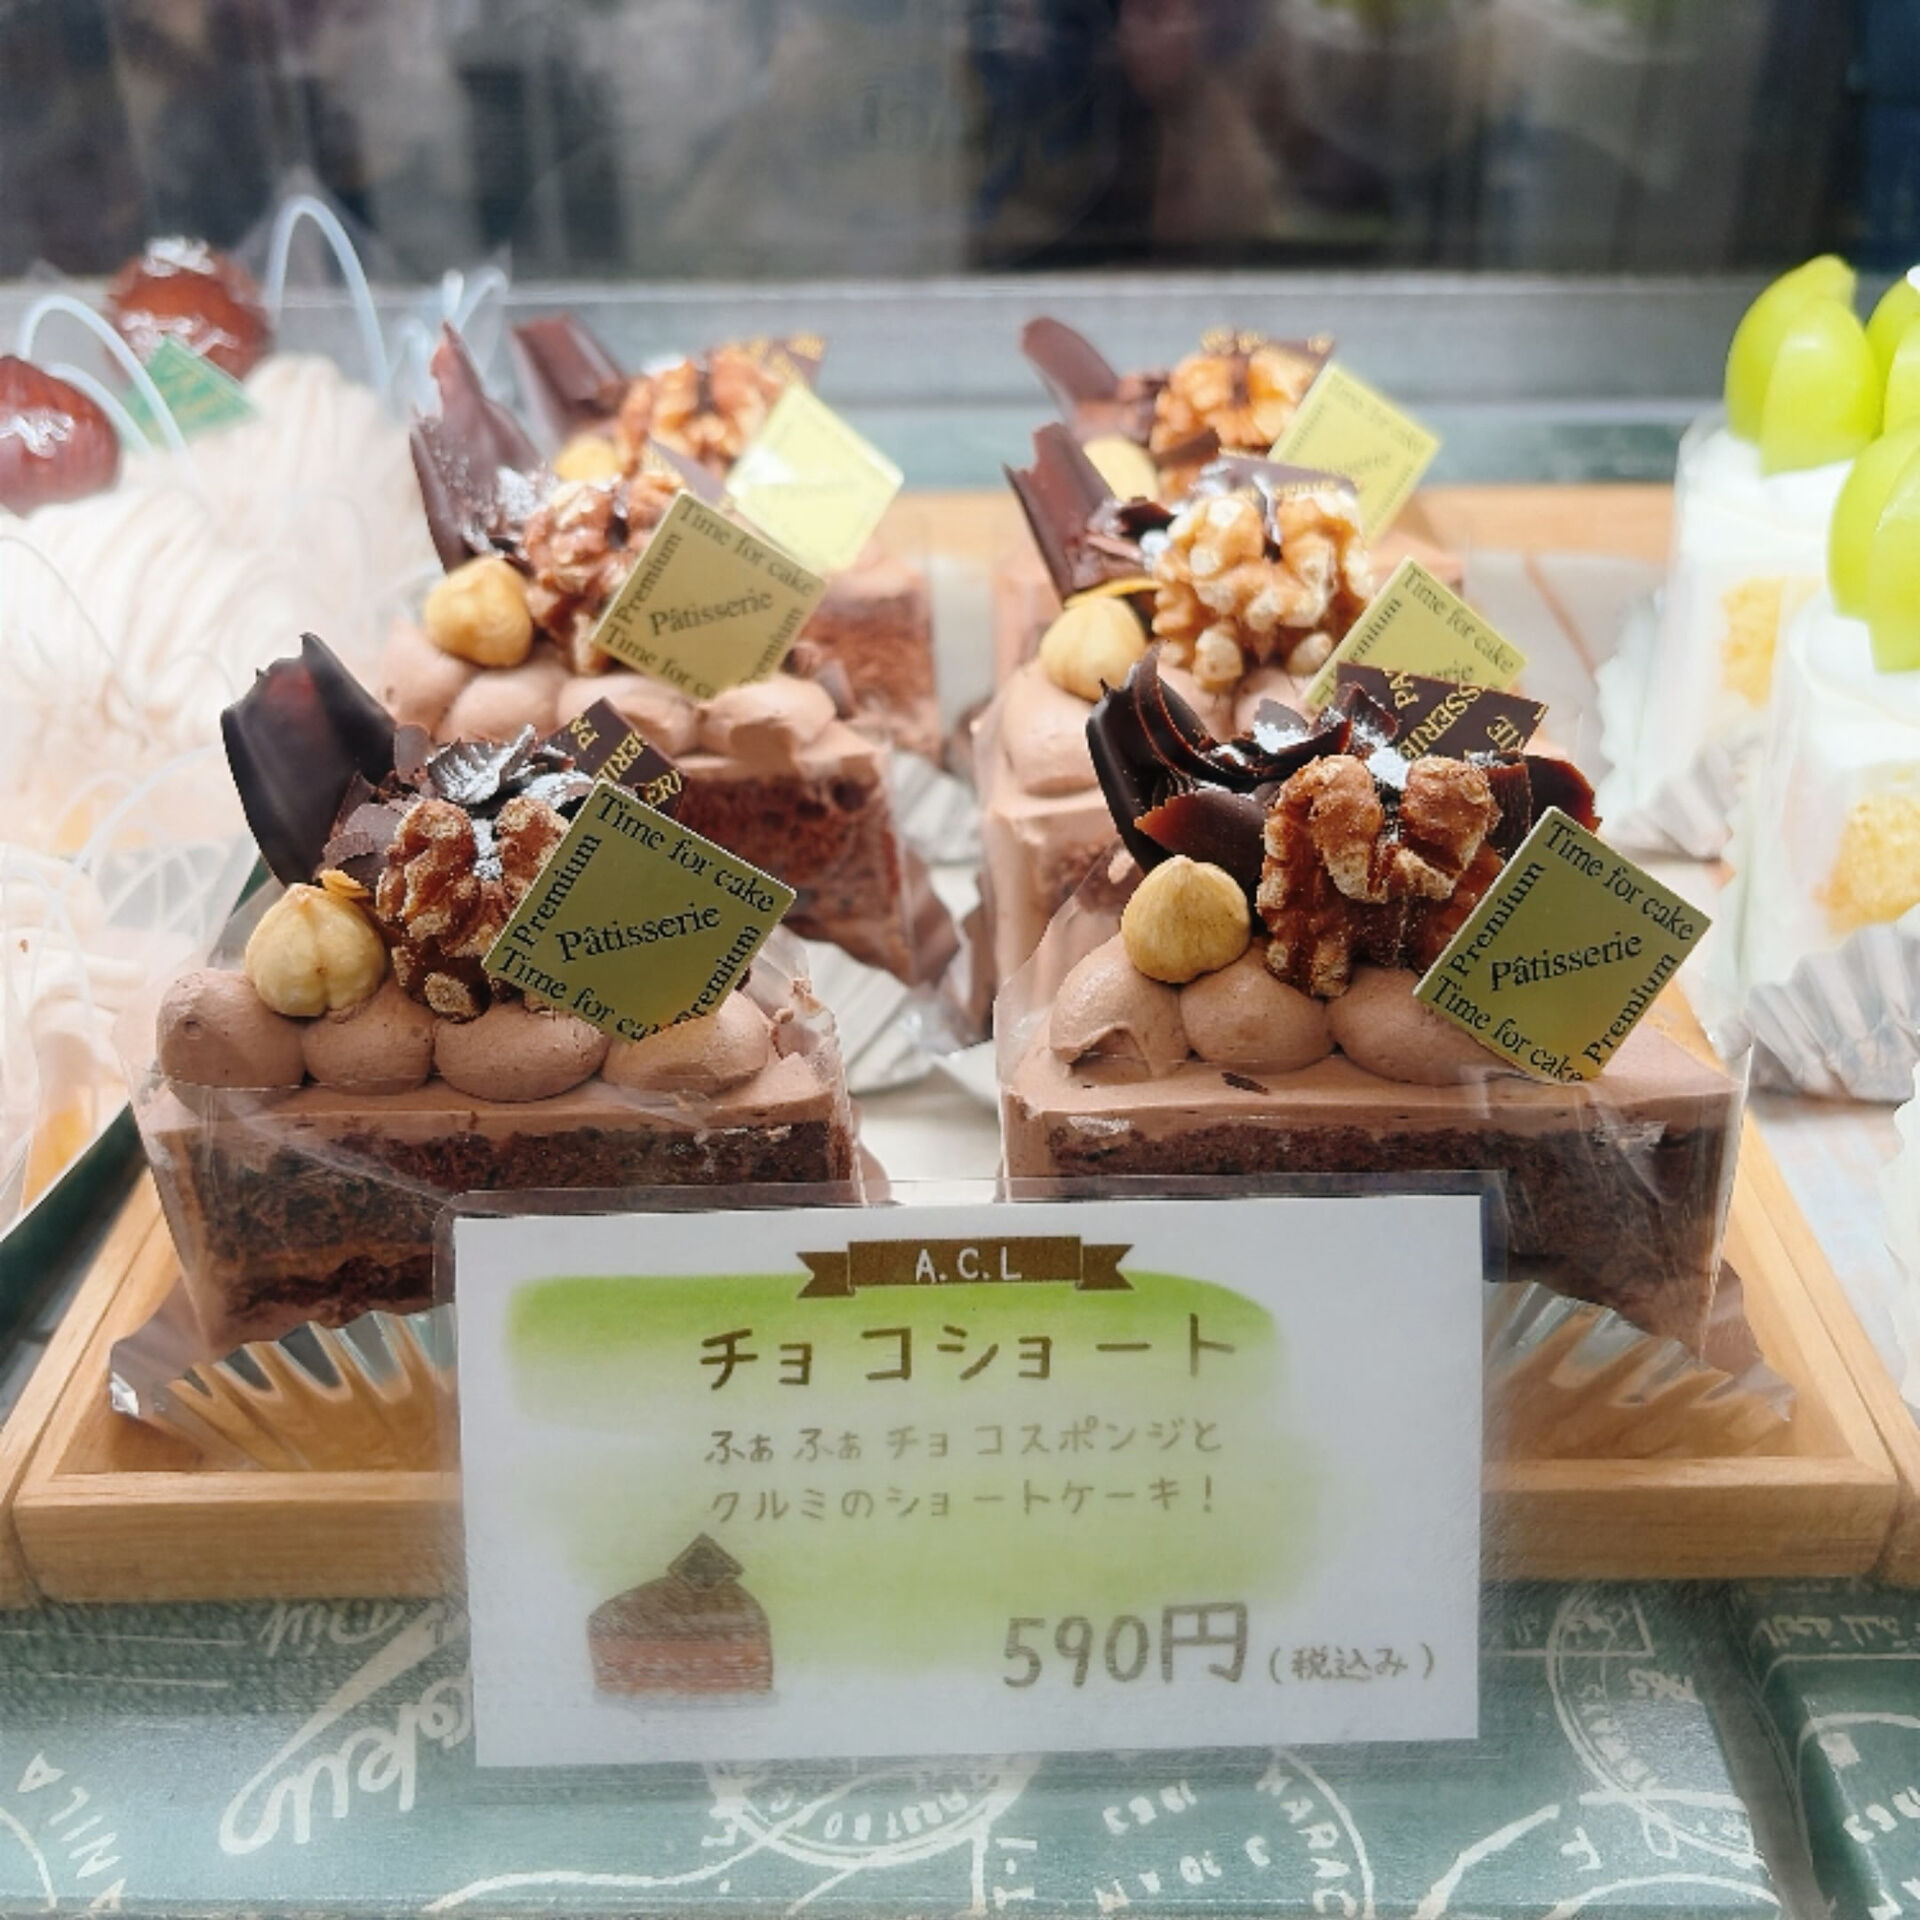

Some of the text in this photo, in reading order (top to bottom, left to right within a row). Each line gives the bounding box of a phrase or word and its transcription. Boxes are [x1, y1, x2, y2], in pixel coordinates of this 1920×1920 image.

[614, 533, 683, 626] Premium
[679, 500, 815, 598] Time for cake
[605, 624, 657, 664] Time
[1401, 567, 1448, 617] Time
[1474, 636, 1515, 675] cake
[511, 832, 602, 949] Premium
[596, 791, 775, 914] Time for cake
[1543, 819, 1694, 941] Time for cake
[555, 902, 724, 965] Pâtisserie
[1447, 861, 1547, 977] Premium
[1489, 931, 1643, 992] Pâtisserie
[498, 945, 568, 1000] Time
[570, 986, 616, 1027] for
[1430, 975, 1492, 1031] Time
[1491, 1017, 1532, 1056] for
[1582, 952, 1678, 1065] Premium
[915, 1246, 1022, 1284] A.C.L
[700, 1313, 1236, 1391] チョコショート
[1002, 1600, 1435, 1688] 590円 (税込み)
